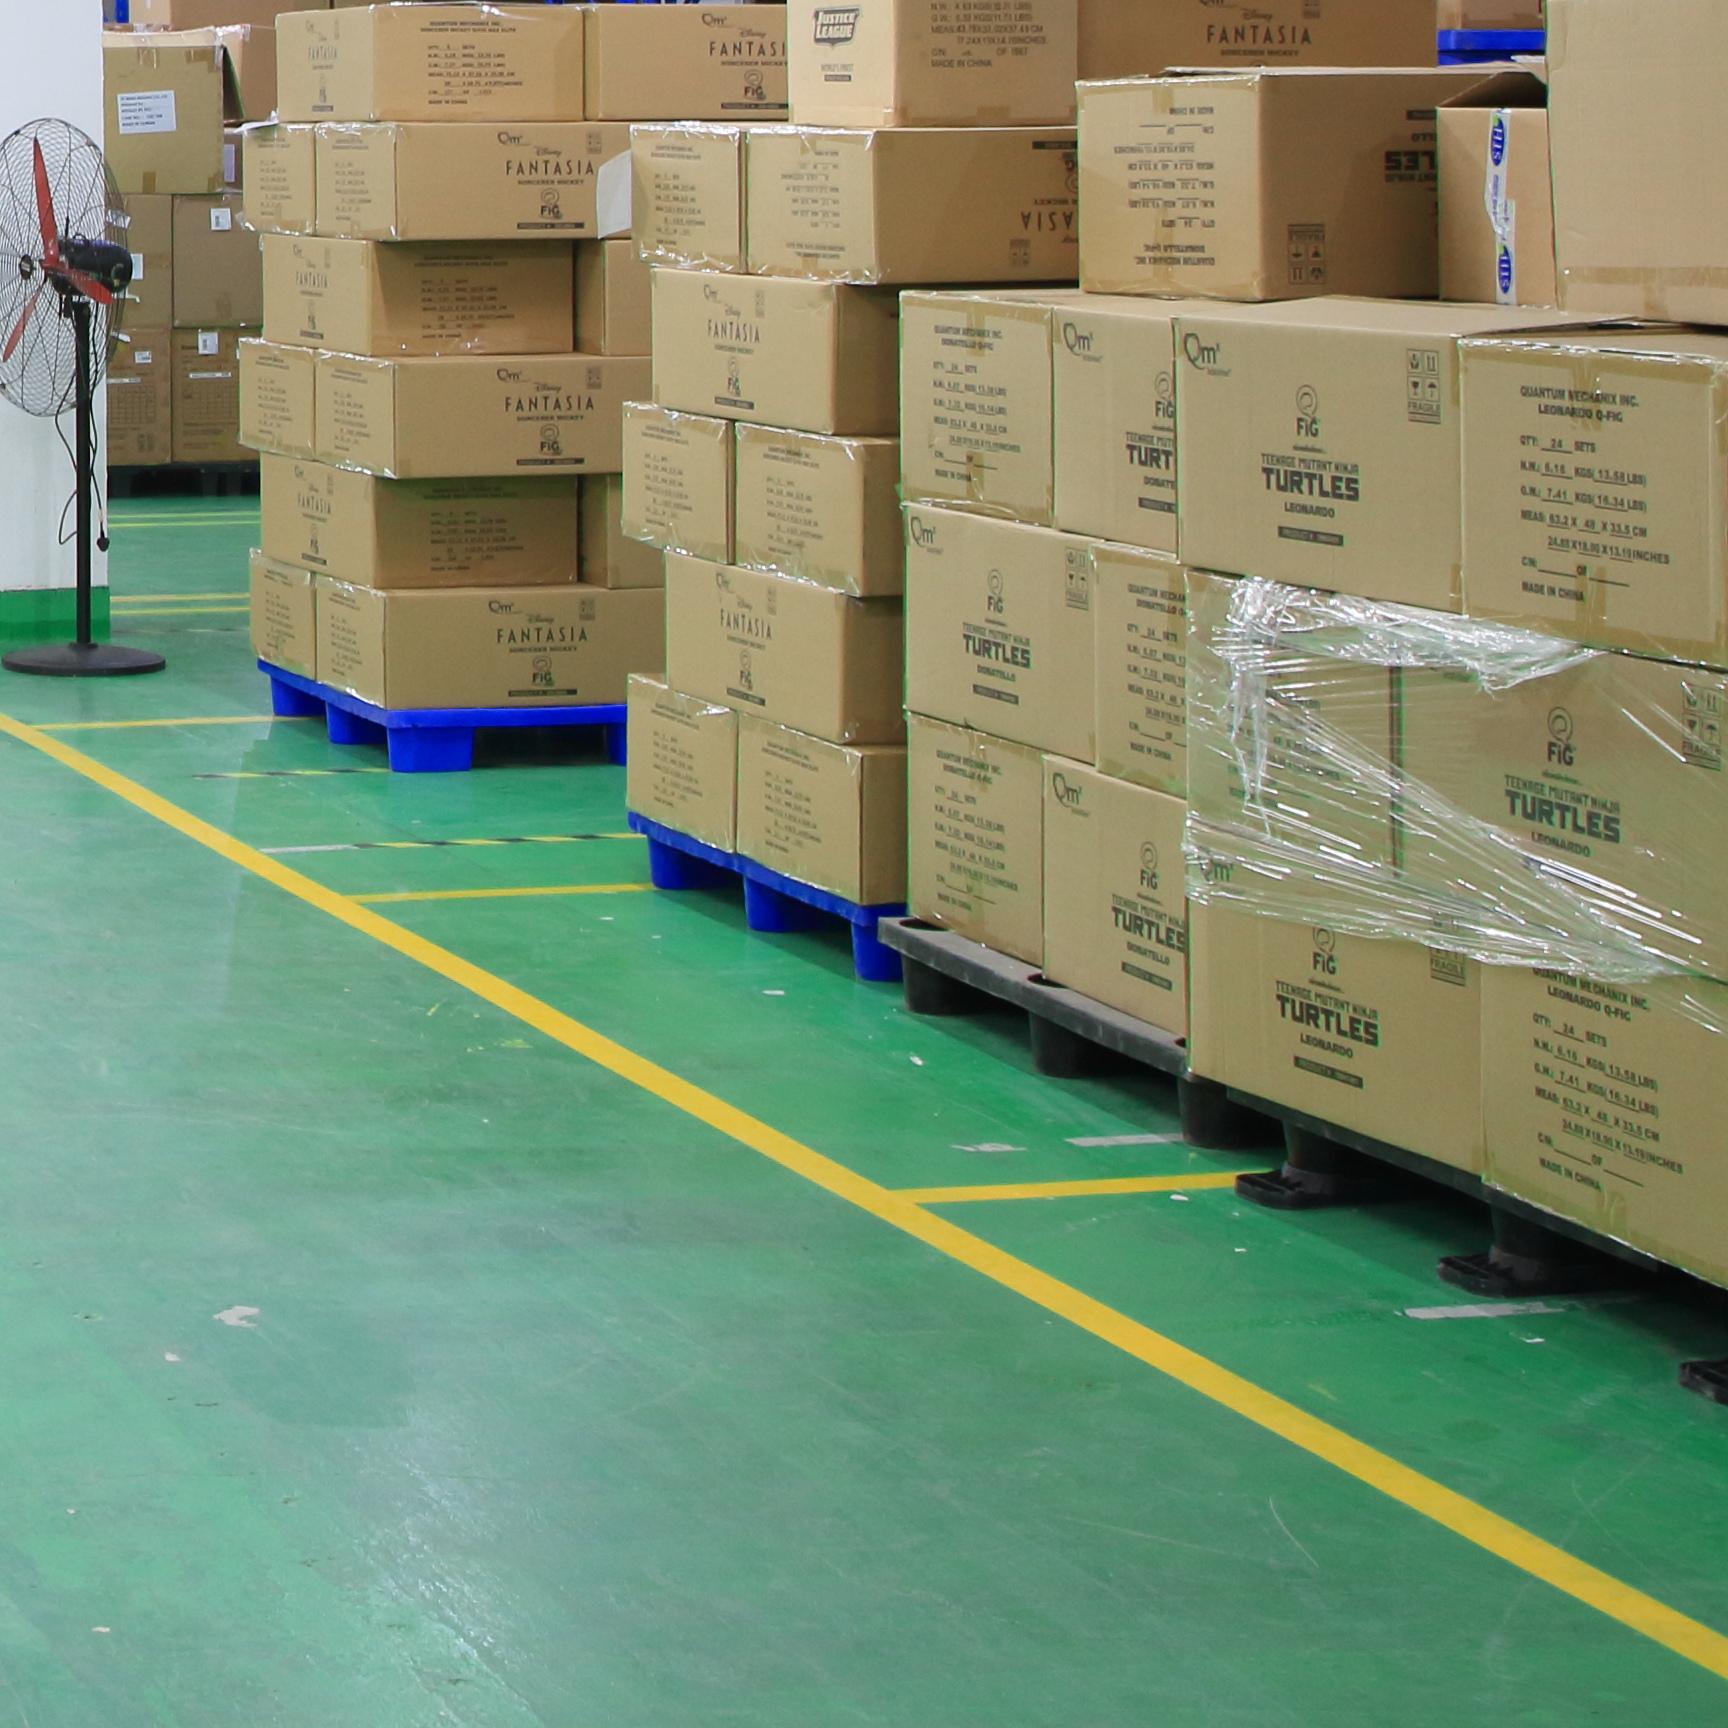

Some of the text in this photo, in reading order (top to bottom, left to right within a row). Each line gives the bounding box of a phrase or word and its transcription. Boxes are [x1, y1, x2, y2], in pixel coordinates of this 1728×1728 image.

[817, 12, 856, 24] JUSTICE
[816, 24, 853, 38] LEAGUE
[1207, 25, 1312, 44] FANTASIA
[710, 41, 785, 56] FANTASI
[931, 59, 955, 68] MADE
[966, 59, 992, 67] CHINA
[1493, 128, 1503, 160] STH
[506, 160, 593, 175] FANTASIA
[1021, 212, 1073, 232] ASIA
[1501, 256, 1509, 287] STH
[708, 319, 759, 343] FANTASIA
[505, 396, 593, 411] FANTASIA
[1520, 386, 1565, 399] QUANTUM
[1408, 401, 1441, 413] FRAGILE
[1538, 404, 1592, 419] LEONARDO
[1126, 444, 1173, 470] TURT
[1574, 442, 1595, 452] SETS
[1261, 453, 1359, 475] TEENAGE MUTANT NINJA
[1262, 467, 1359, 501] TURTLES
[1284, 502, 1335, 519] LEONARDO
[1522, 581, 1544, 596] MADE
[1559, 587, 1584, 602] CHINA
[497, 627, 587, 643] FANTASIA
[721, 608, 771, 640] FANTASIA
[963, 634, 1030, 669] TURTLES
[1505, 775, 1545, 796] TEENAGE
[1548, 785, 1589, 806] MUTANT
[1591, 797, 1620, 814] NINJA
[1505, 789, 1621, 844] TURTLES
[1532, 832, 1590, 857] LEONARDO
[1112, 906, 1184, 953] TURTLES
[1276, 980, 1312, 1002] TEENAGE
[1315, 988, 1349, 1012] MUTANT
[1352, 1004, 1377, 1020] NINJA
[1548, 986, 1631, 1021] LEONARDO Q-FIG
[1276, 994, 1379, 1047] TURTLES
[1300, 1033, 1353, 1058] LEONARDO
[1563, 1023, 1574, 1035] 24
[1586, 1031, 1607, 1047] SETS
[1540, 1157, 1601, 1191] MADE IN CHINA
